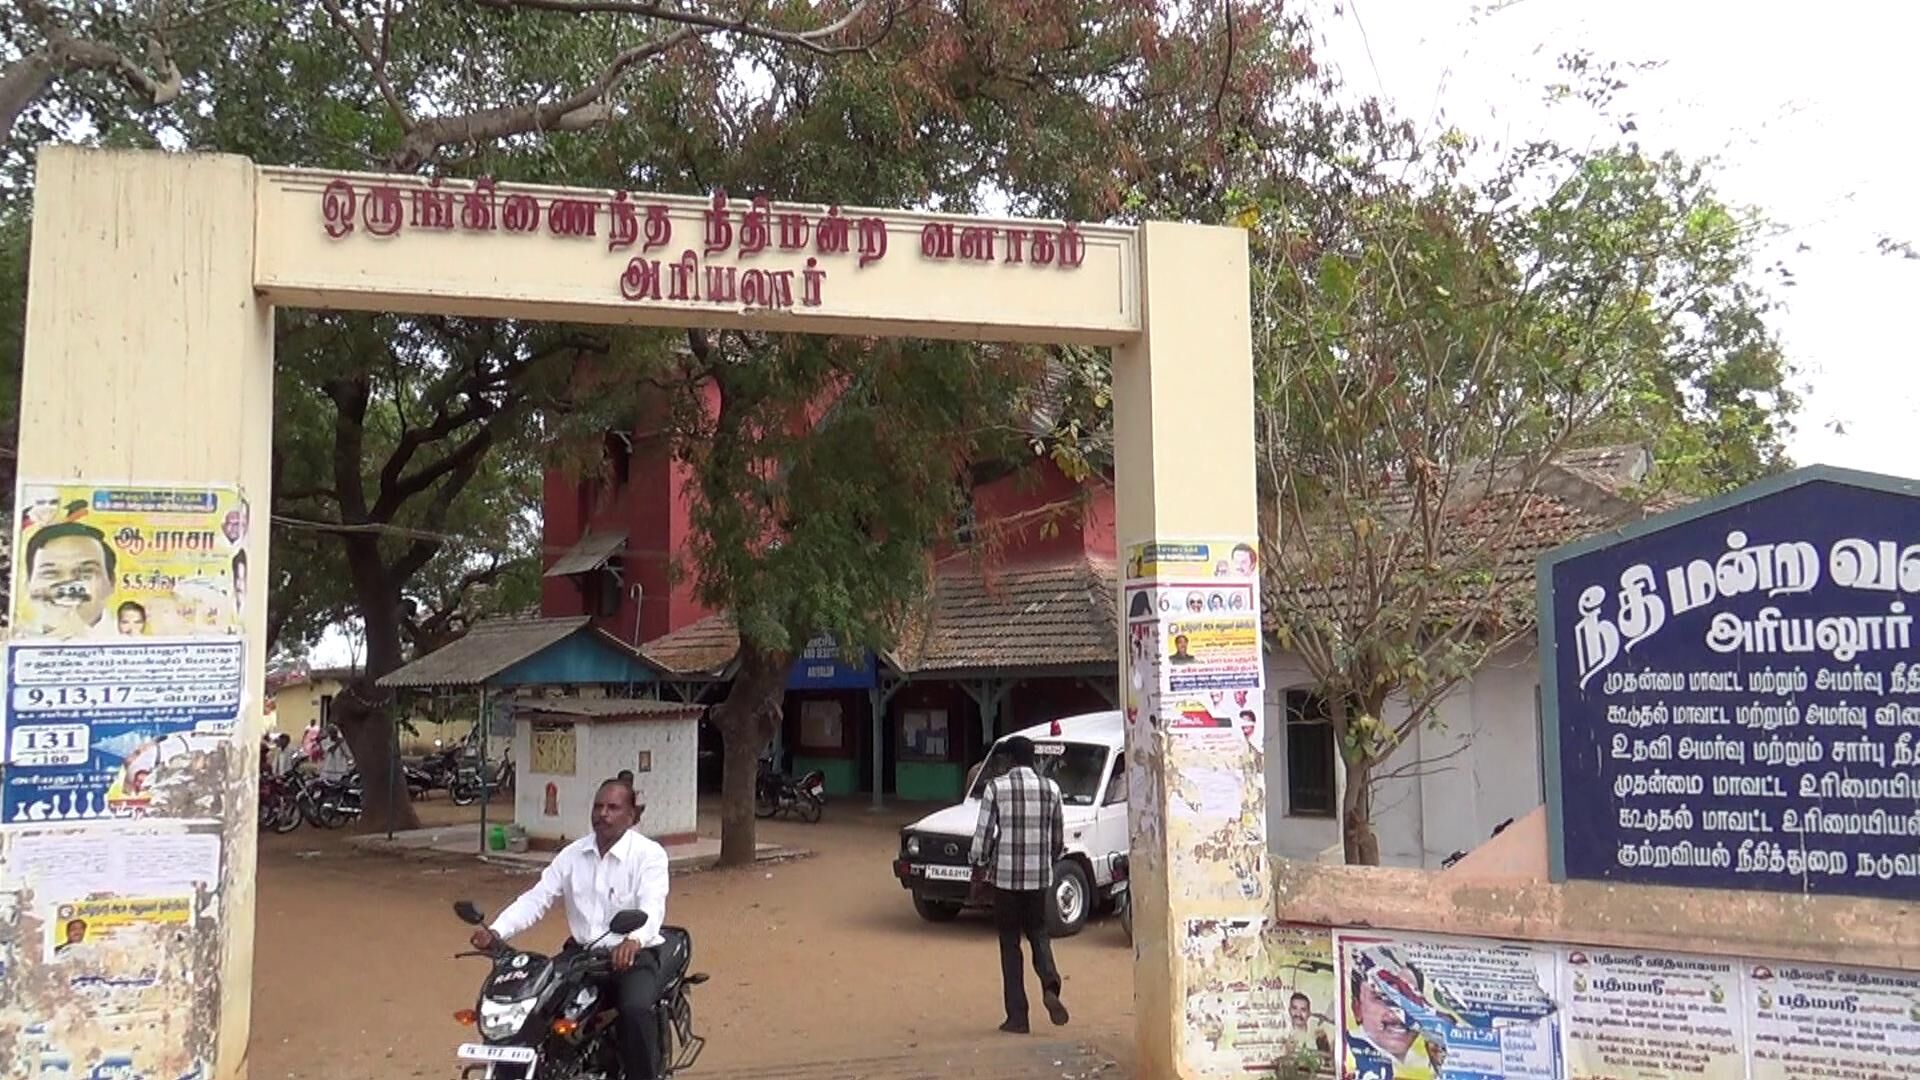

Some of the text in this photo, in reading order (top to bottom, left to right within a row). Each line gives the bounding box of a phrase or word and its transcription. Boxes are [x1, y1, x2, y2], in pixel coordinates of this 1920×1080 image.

[321, 174, 1087, 268] ஒருங்கிணைந்த நீதிமன்ற வளாகம்
[620, 248, 828, 310] அரியலூர்
[1574, 531, 1820, 690] நீதிமன்ற
[1706, 601, 1913, 662] அரியலூர்
[1604, 666, 1684, 695] முதன்மை
[1689, 671, 1743, 691] மாவட்ட
[1749, 669, 1807, 696] மற்றும்
[1815, 668, 1882, 695] அமர்வு
[1607, 701, 1668, 728] கூடுதல்
[1673, 704, 1729, 725] மாவட்ட
[1736, 702, 1800, 730] மற்றும்
[1806, 702, 1867, 729] அமர்வு
[26, 732, 75, 749] 131
[1611, 734, 1672, 762] உதவி
[1678, 737, 1744, 764] அமர்வு
[1753, 735, 1823, 766] மற்றும்
[1613, 768, 1703, 796] முதன்மை
[1713, 772, 1787, 797] மாவட்ட
[1620, 804, 1692, 832] கூடுதல்
[1703, 808, 1773, 832] மாவட்ட
[1618, 840, 1731, 869] குற்றவியல்
[1736, 841, 1847, 874] நீதித்துறை
